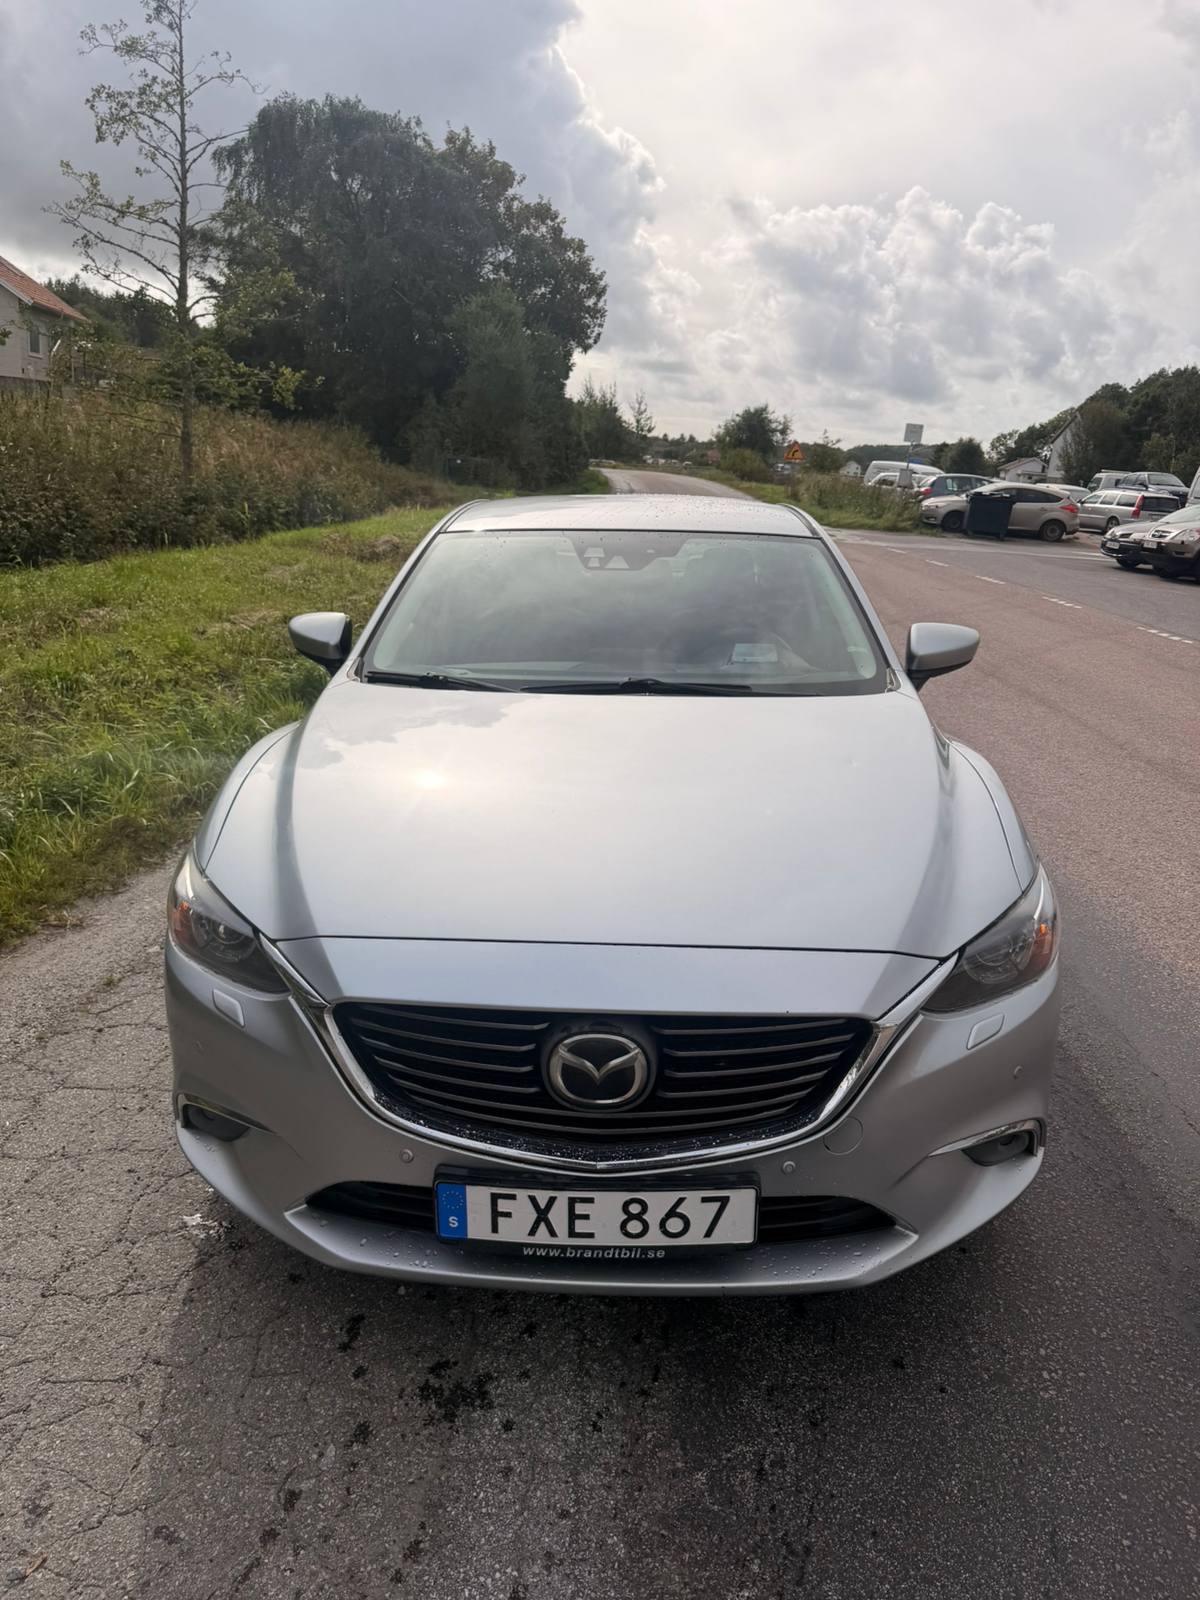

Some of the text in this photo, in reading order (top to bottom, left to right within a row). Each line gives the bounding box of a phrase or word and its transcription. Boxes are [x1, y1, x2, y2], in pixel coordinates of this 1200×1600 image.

[448, 1216, 459, 1228] S
[490, 1192, 731, 1239] FXE 867
[522, 1246, 666, 1259] www.brandtbil.se
